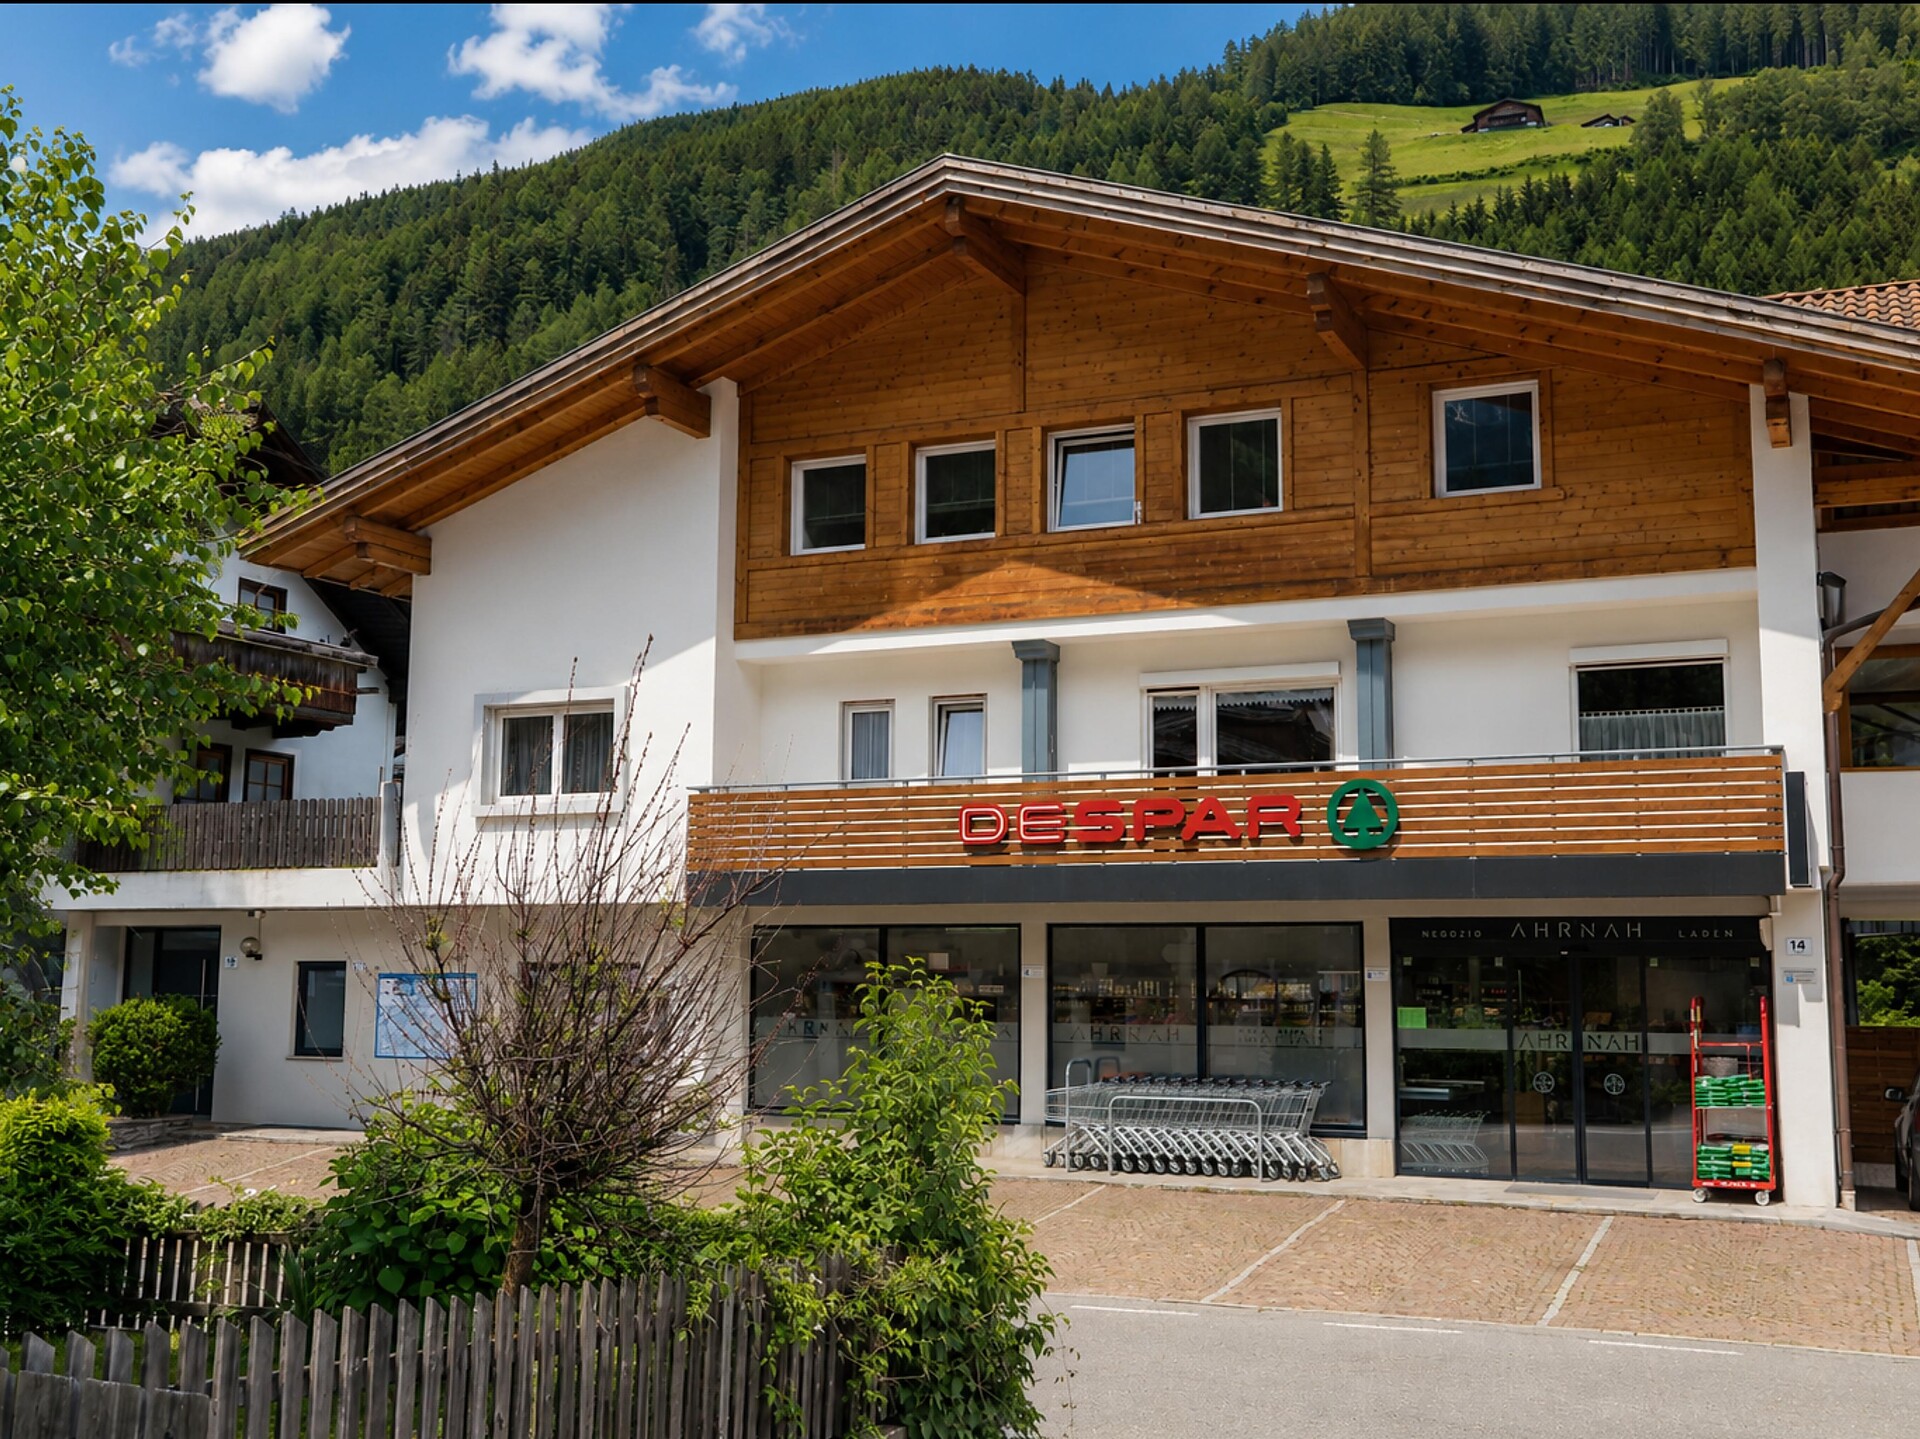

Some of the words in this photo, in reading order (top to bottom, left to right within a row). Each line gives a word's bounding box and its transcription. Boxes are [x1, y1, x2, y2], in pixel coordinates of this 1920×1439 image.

[959, 794, 1302, 845] DESPAR
[1422, 929, 1483, 938] NEGOZIO
[1511, 921, 1642, 938] AHRNAH
[1678, 929, 1734, 938] LADEN
[1790, 940, 1806, 951] 14
